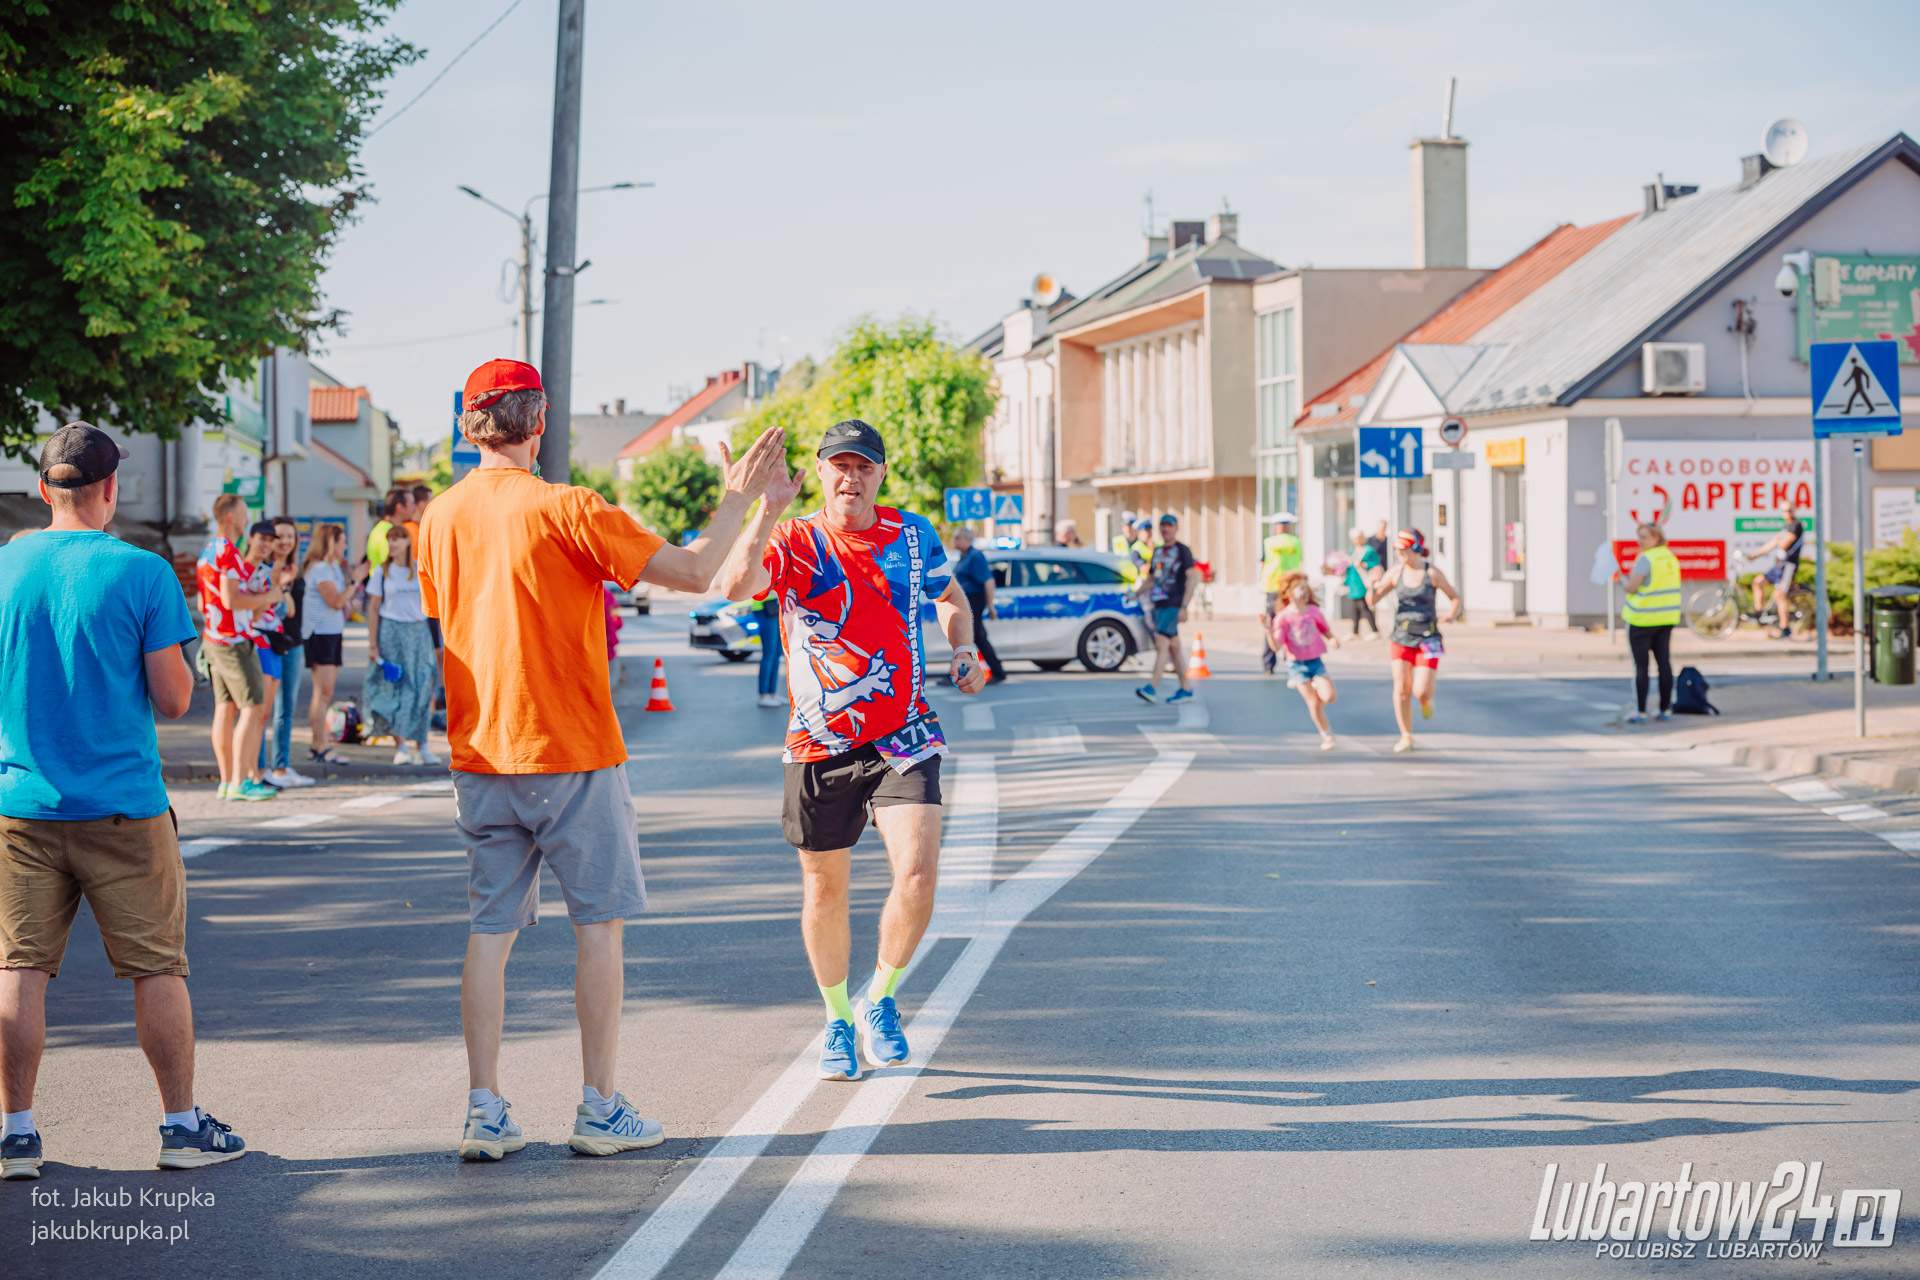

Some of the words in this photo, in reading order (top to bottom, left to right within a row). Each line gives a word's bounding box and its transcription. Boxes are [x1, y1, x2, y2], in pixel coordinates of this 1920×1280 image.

[1627, 458, 1813, 476] CAŁODOBOWA
[1682, 481, 1812, 510] APTEKA
[890, 721, 935, 753] 171
